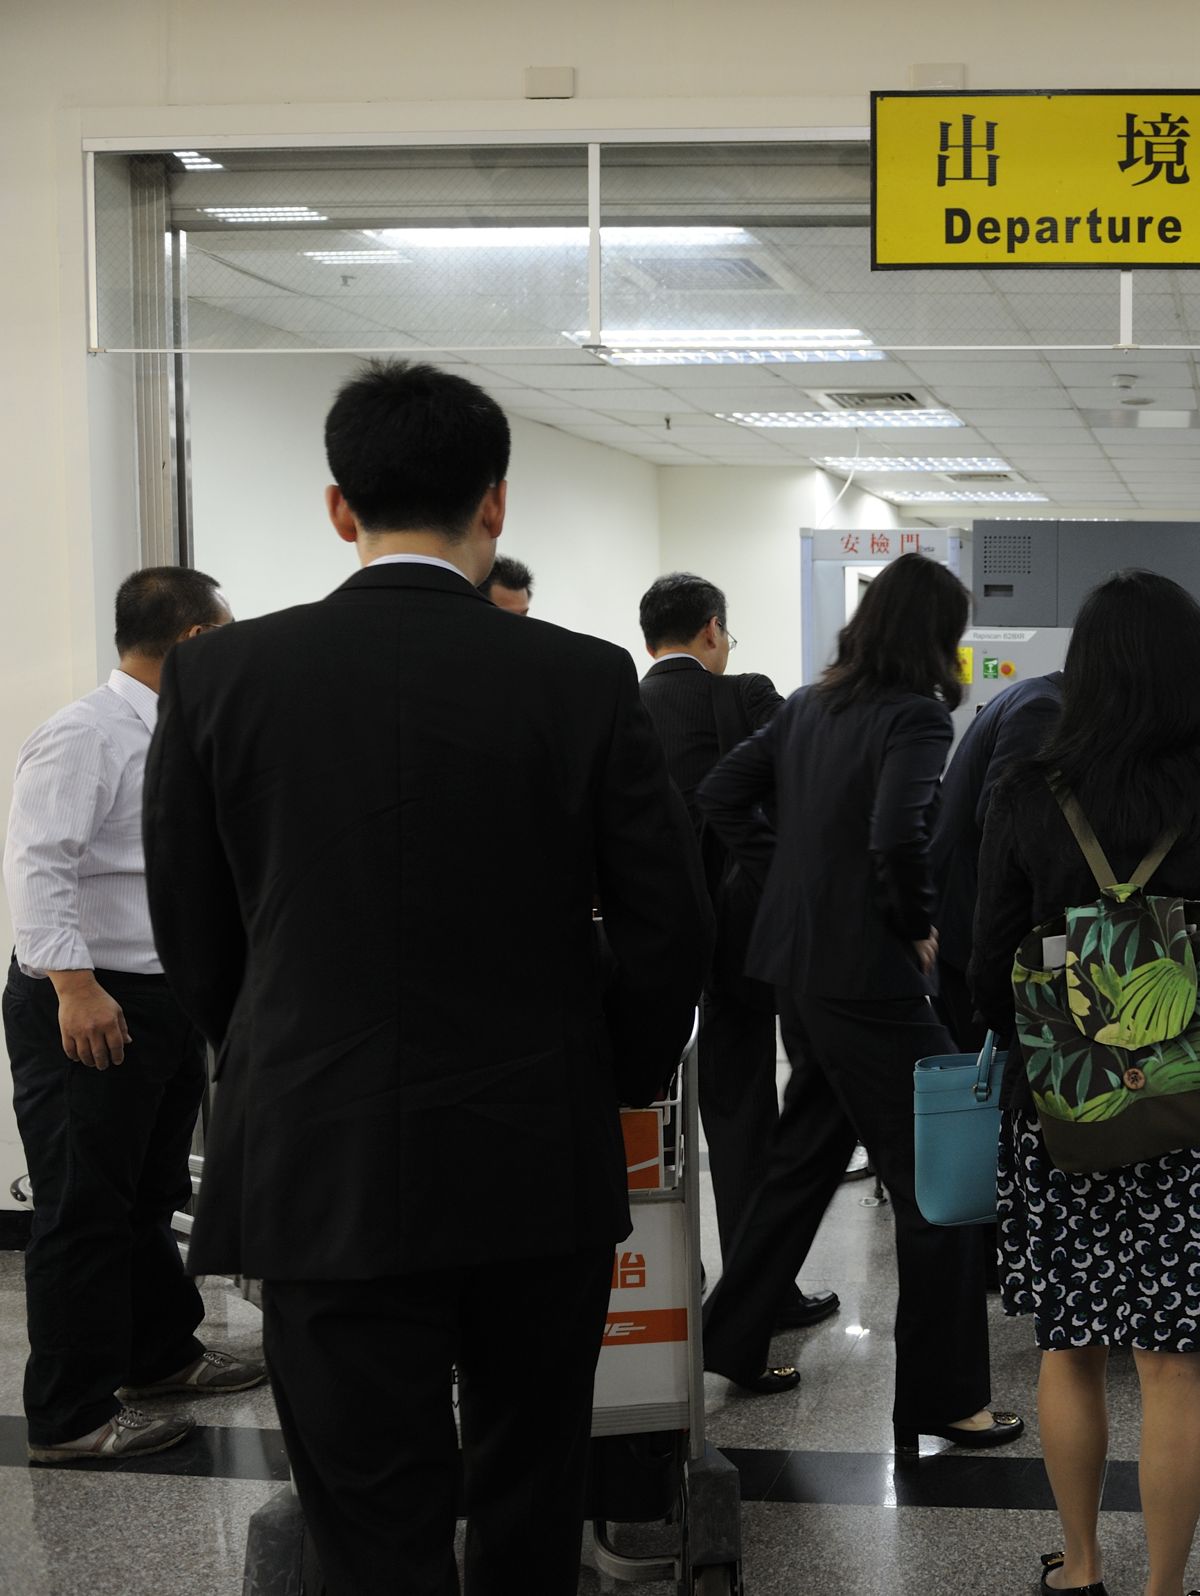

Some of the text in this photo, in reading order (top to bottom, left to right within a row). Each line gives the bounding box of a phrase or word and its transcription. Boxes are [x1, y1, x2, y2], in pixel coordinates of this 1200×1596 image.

[936, 112, 1191, 187] 出境
[944, 207, 1182, 253] Departure
[840, 533, 920, 554] 安檢門
